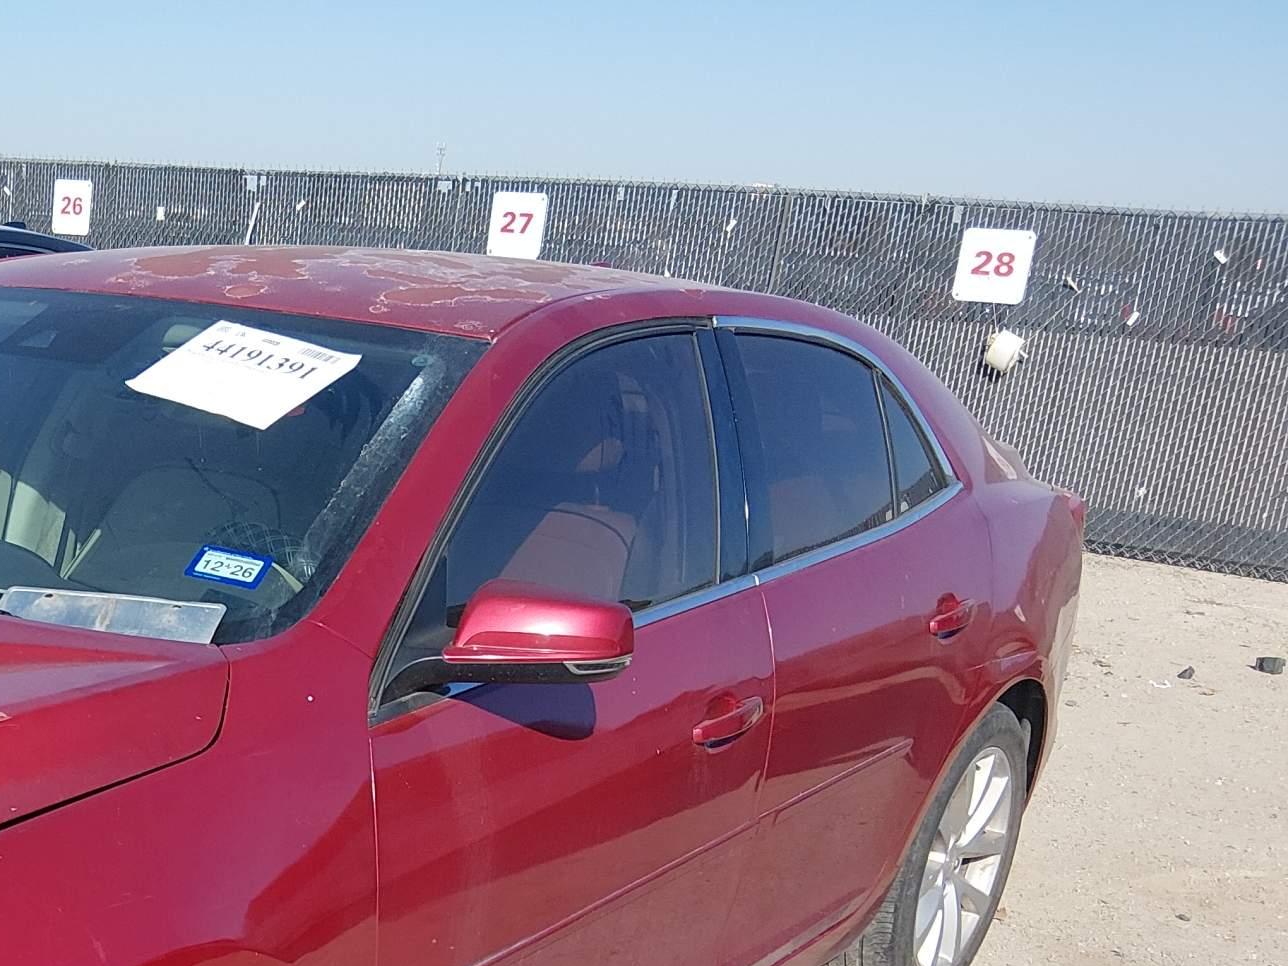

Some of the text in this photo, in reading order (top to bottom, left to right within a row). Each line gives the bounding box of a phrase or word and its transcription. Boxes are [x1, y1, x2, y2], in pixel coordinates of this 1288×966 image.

[61, 196, 83, 216] 26
[500, 211, 534, 234] 27
[970, 250, 1016, 278] 28
[202, 339, 319, 380] 44191391
